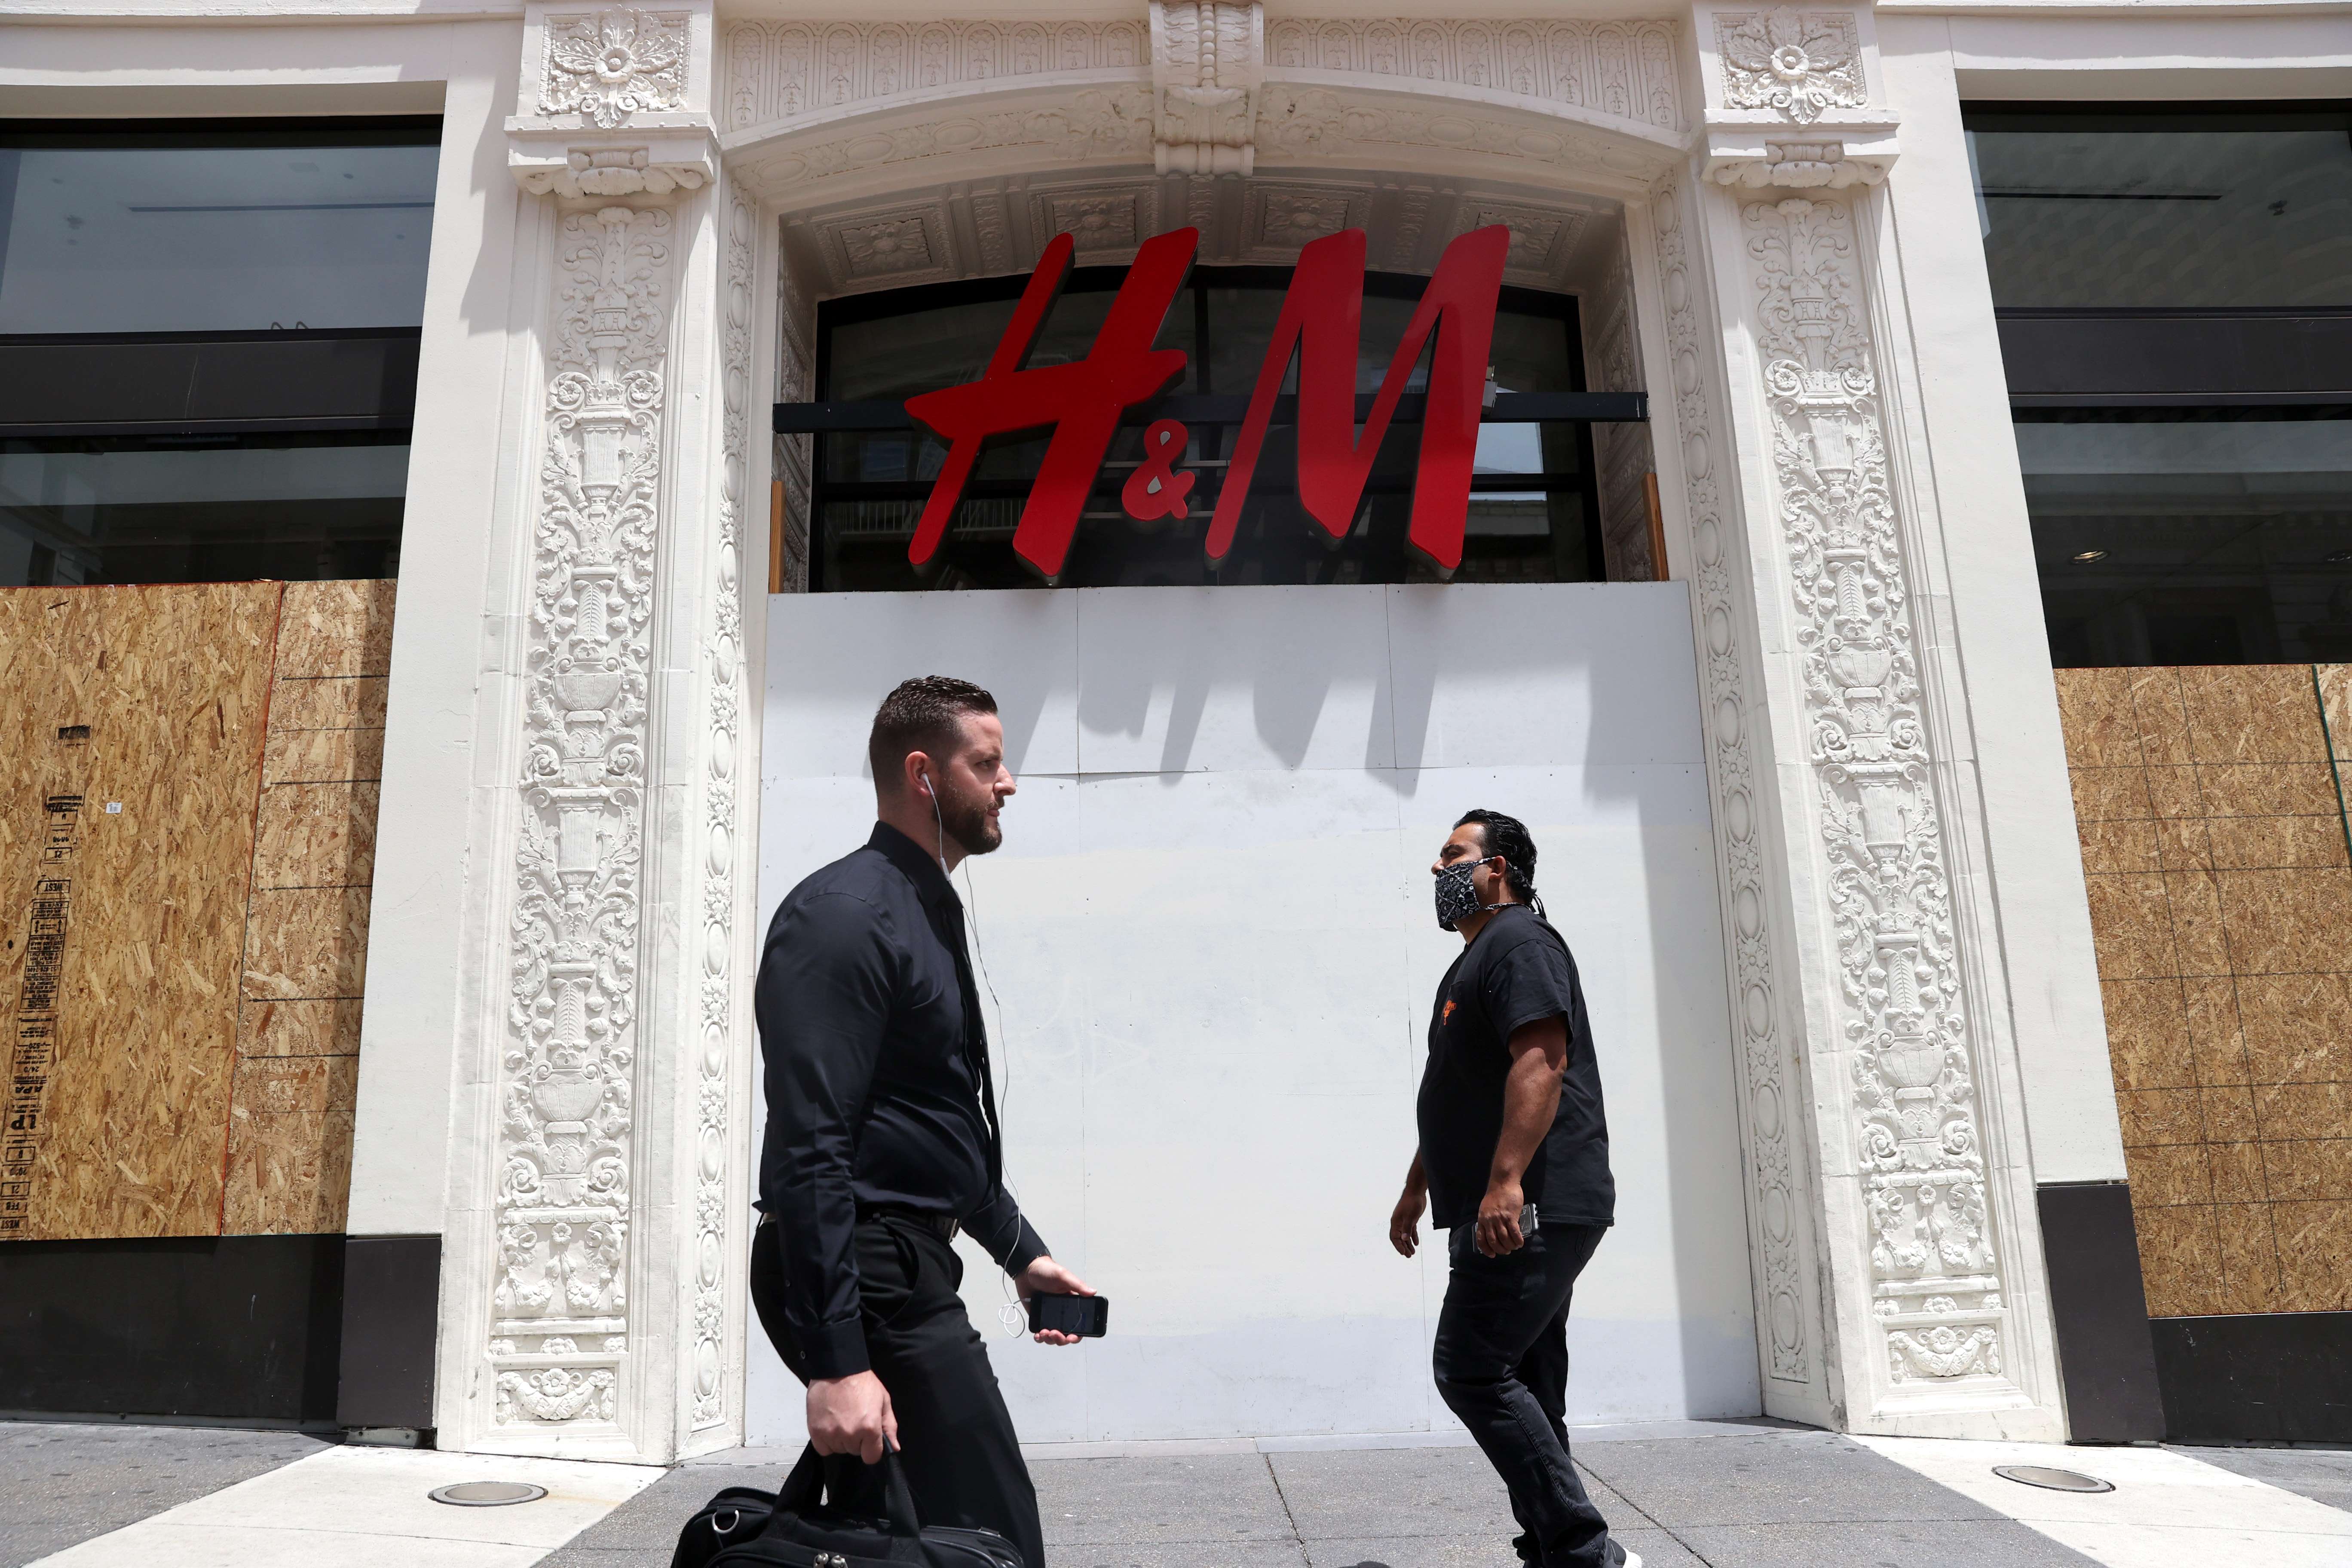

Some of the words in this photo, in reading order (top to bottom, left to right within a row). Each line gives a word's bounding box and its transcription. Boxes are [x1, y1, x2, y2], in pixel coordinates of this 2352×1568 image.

[903, 224, 1510, 579] H&M
[44, 882, 63, 891] WEST
[11, 1115, 36, 1130] LP
[12, 1185, 20, 1194] 21
[1, 1220, 20, 1229] WEST
